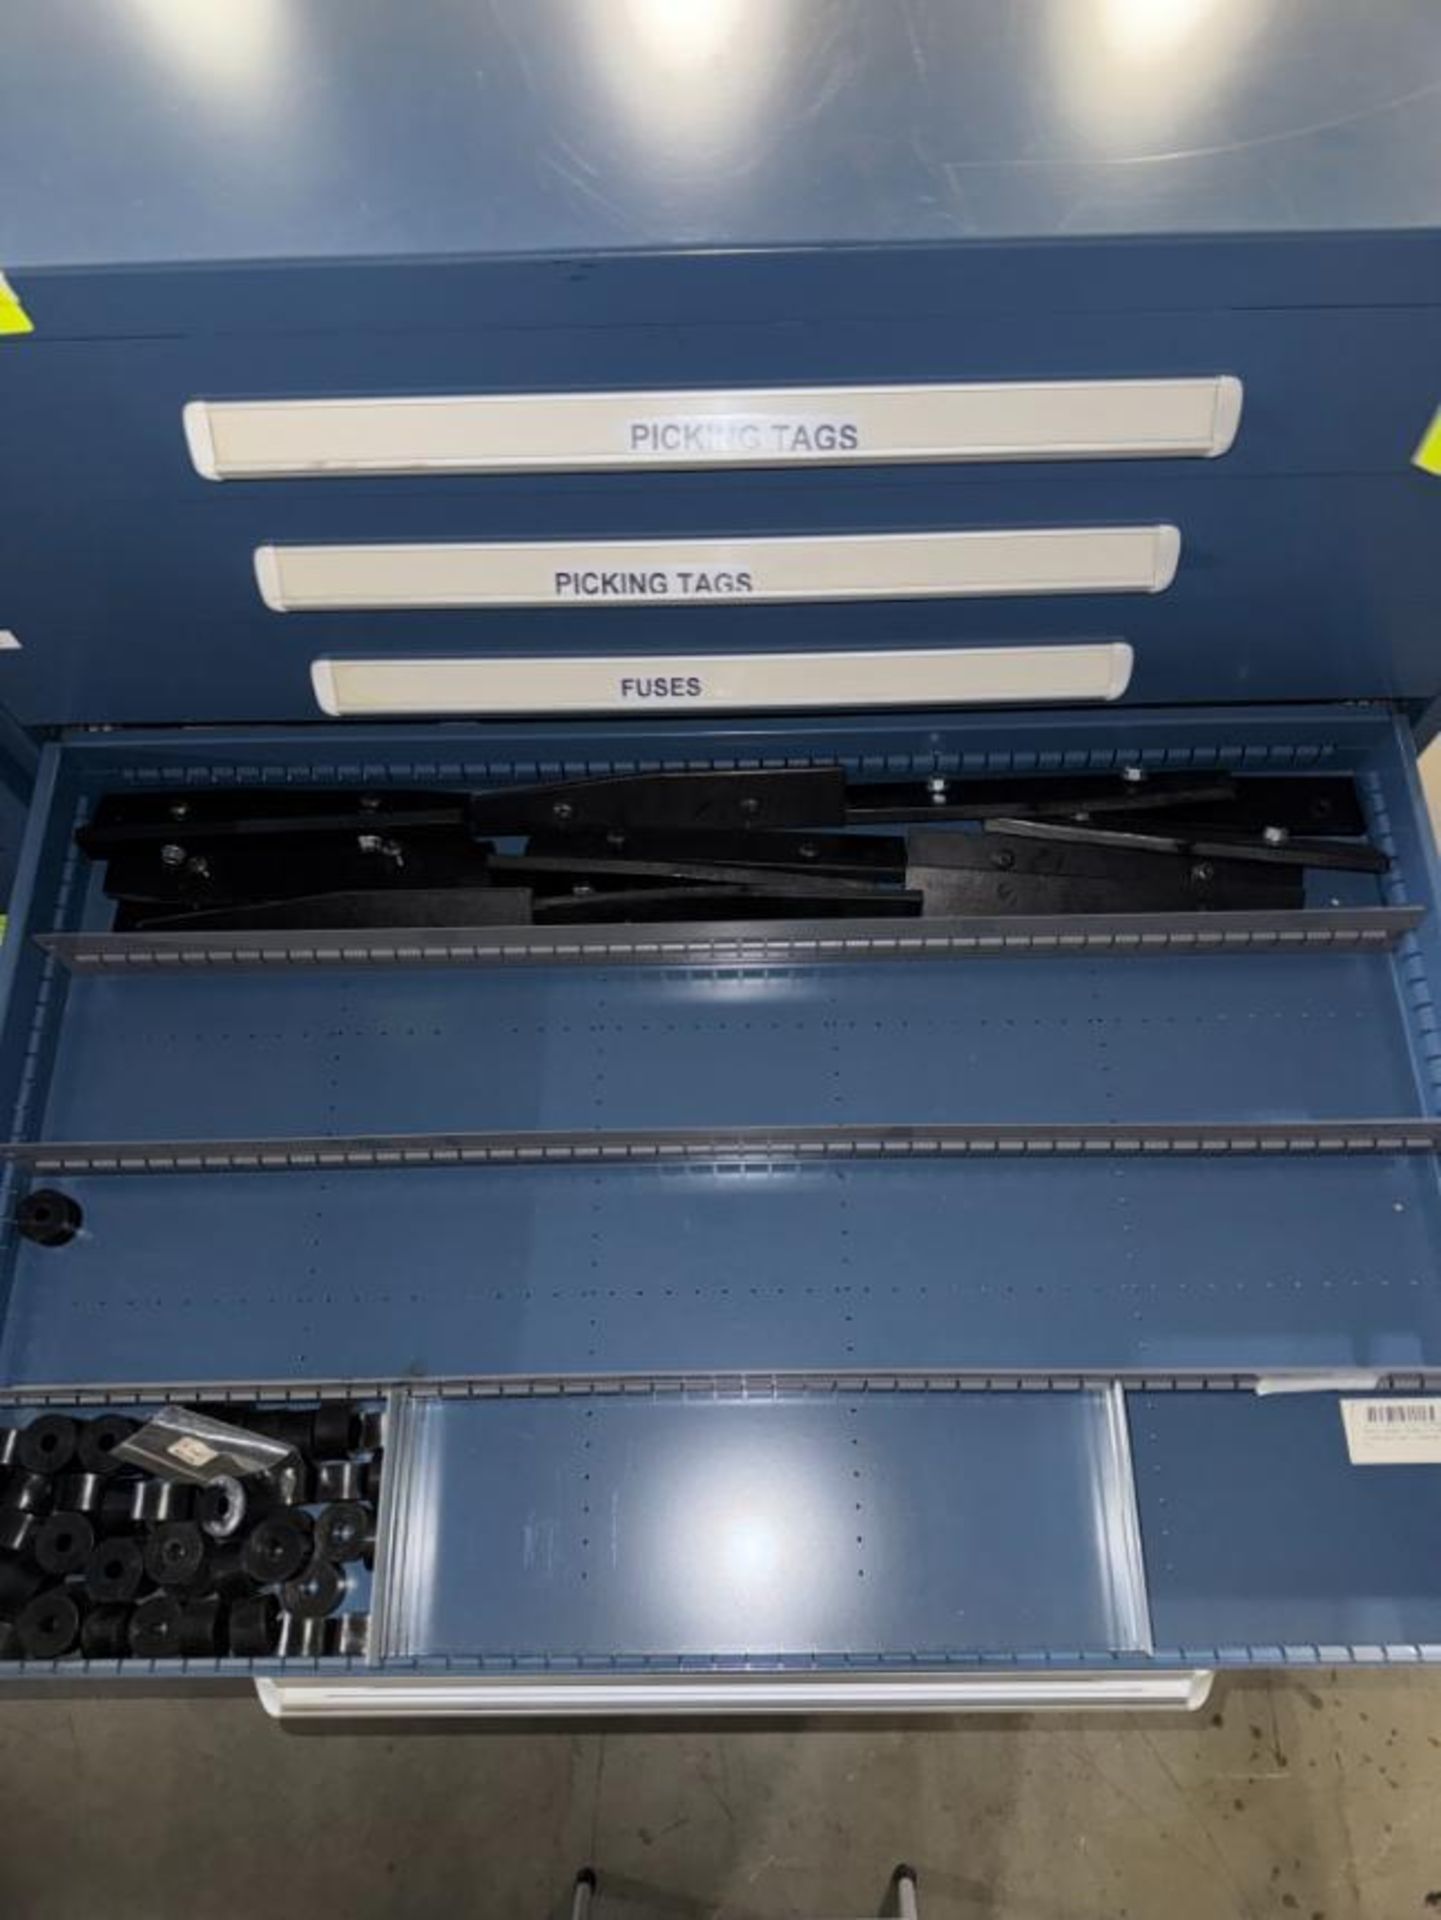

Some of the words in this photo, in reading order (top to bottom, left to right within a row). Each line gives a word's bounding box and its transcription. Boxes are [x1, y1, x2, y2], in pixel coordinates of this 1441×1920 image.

[771, 424, 859, 451] TAGS
[555, 572, 668, 595] PICKING
[677, 572, 753, 593] TAGS
[621, 677, 702, 698] FUSES
